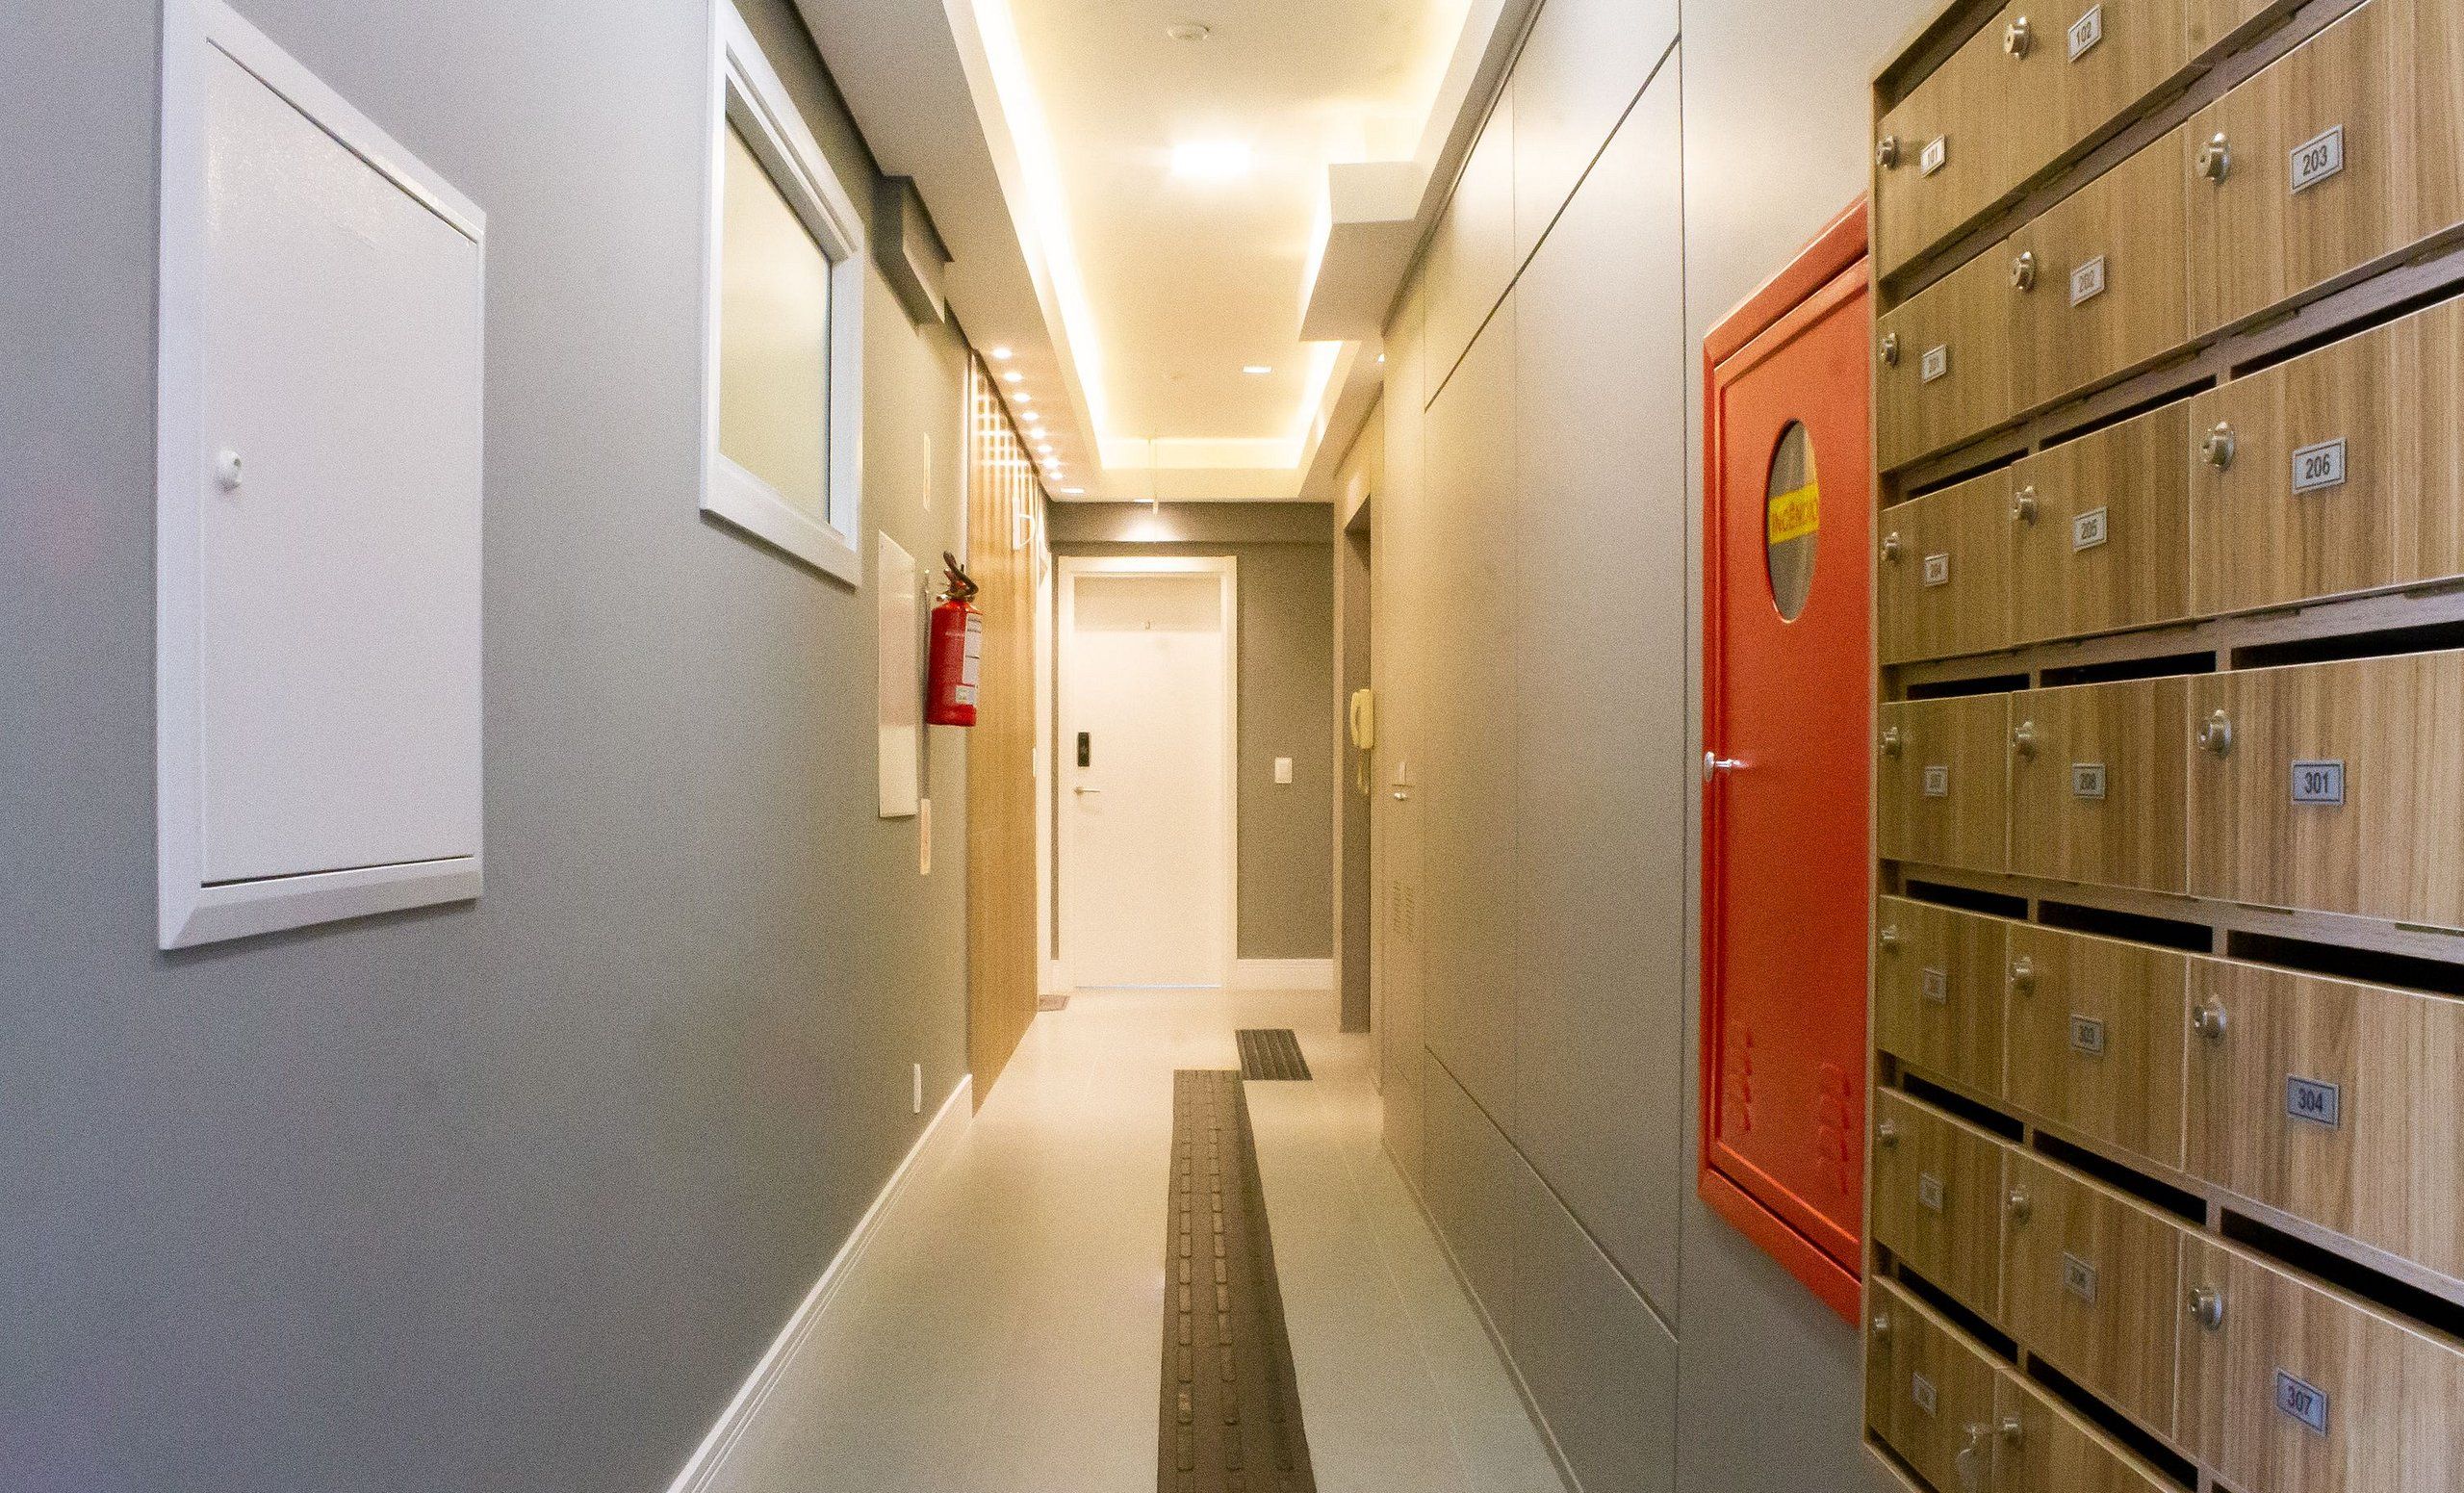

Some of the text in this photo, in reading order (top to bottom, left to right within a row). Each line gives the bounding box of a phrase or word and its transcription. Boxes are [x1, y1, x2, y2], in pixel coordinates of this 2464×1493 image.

[2076, 21, 2092, 45] 102
[2302, 145, 2328, 176] 203
[2305, 453, 2330, 479] 206
[2304, 772, 2328, 794] 301
[2297, 1087, 2323, 1113] 304
[2287, 1385, 2313, 1416] 307
